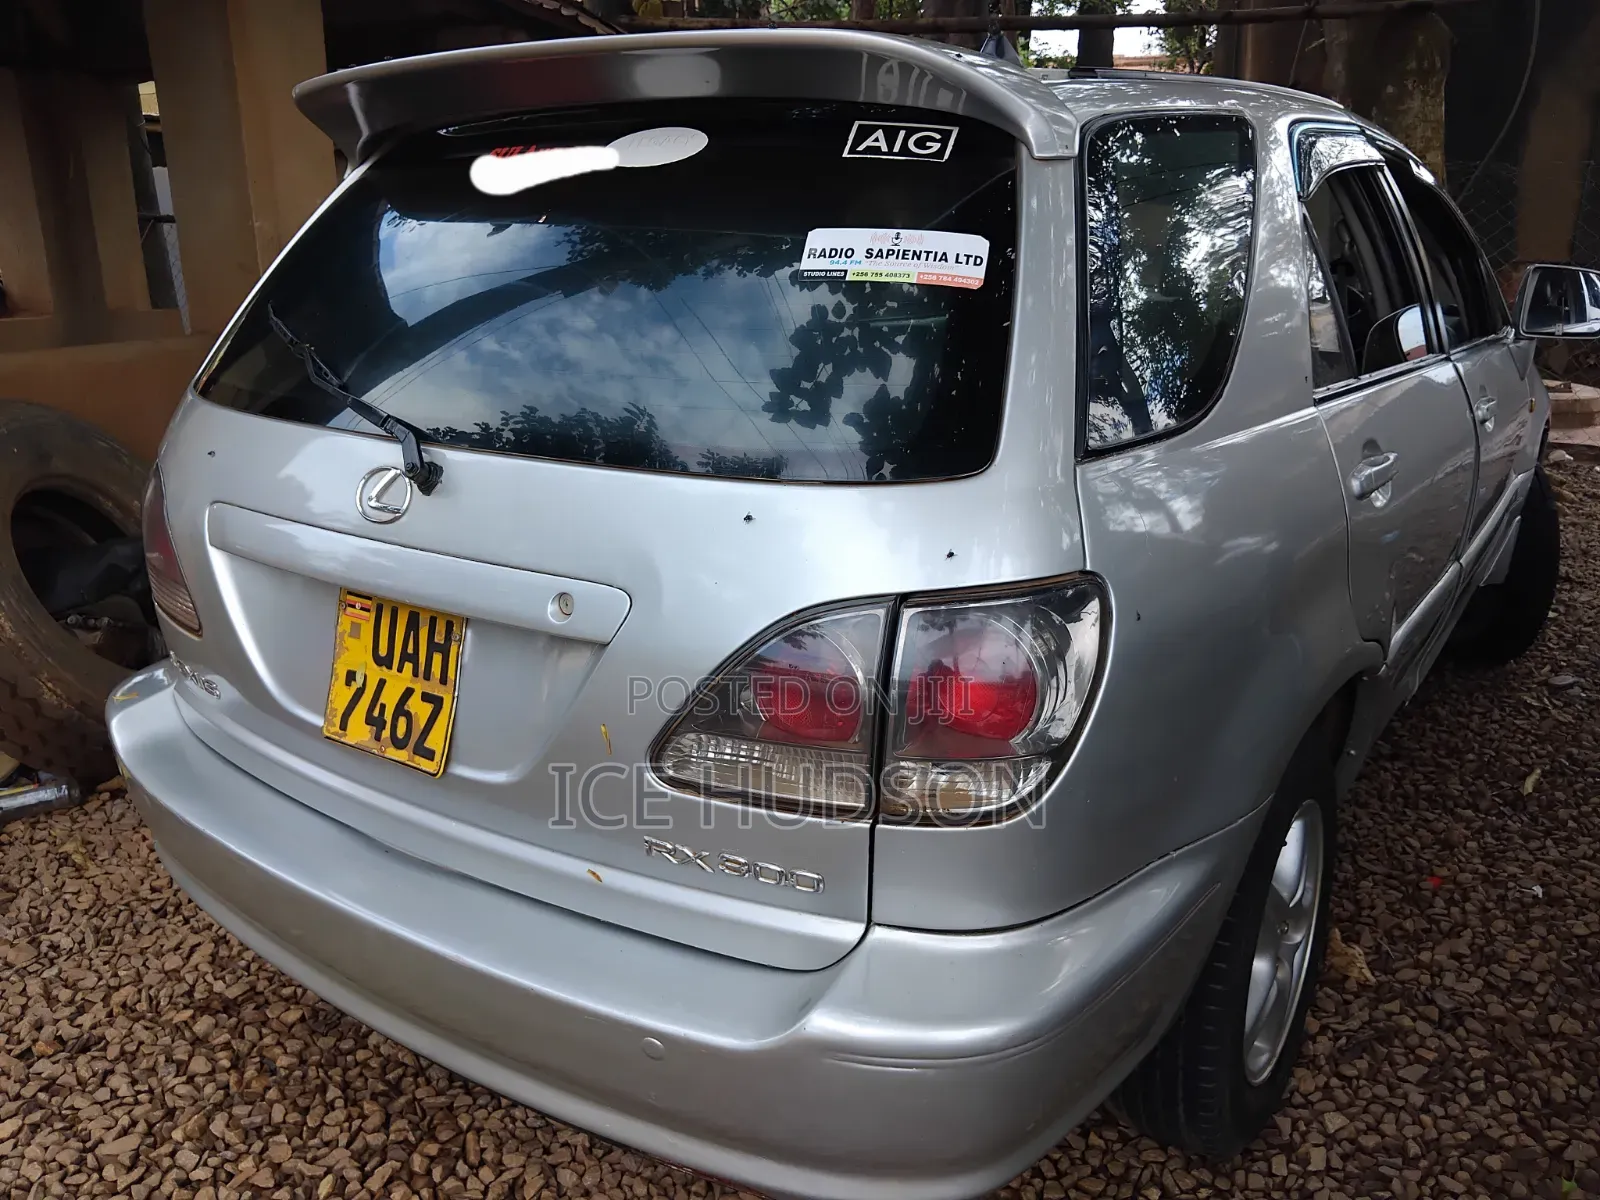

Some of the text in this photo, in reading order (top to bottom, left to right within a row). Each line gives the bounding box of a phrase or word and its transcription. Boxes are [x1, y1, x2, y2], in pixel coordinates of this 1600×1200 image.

[856, 128, 942, 155] AIG
[807, 247, 984, 267] RADIO SAPIENTIA LTD
[371, 602, 454, 686] UAH
